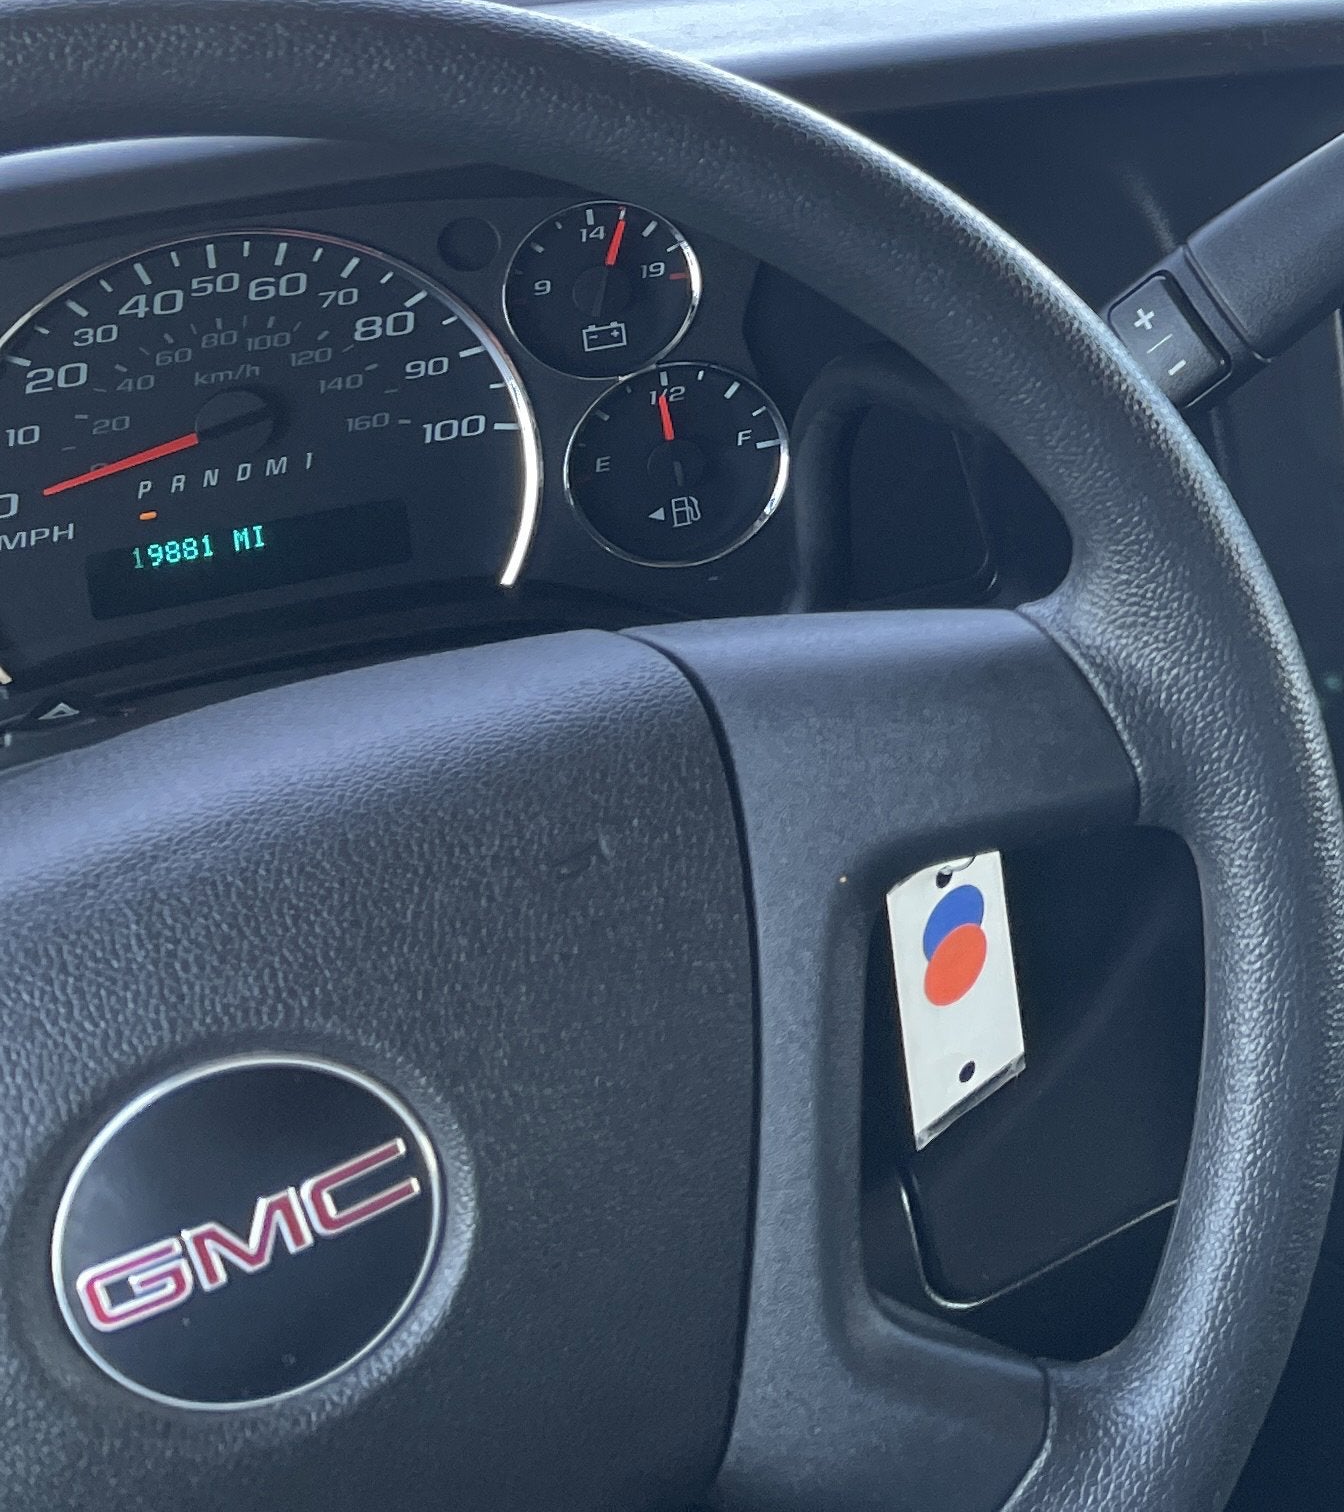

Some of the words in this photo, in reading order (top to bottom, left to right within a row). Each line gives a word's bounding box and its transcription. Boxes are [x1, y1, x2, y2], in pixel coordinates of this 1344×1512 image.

[579, 225, 606, 243] 14
[640, 261, 666, 280] 19
[190, 271, 240, 297] 50
[247, 272, 308, 301] 60
[533, 279, 552, 296] 9
[117, 289, 184, 318] 40
[318, 286, 360, 308] 70
[72, 324, 118, 347] 30
[353, 309, 418, 343] 80
[201, 329, 238, 349] 80
[246, 331, 292, 351] 100
[154, 347, 193, 366] 60
[290, 347, 333, 367] 120
[25, 362, 88, 395] 20
[194, 364, 261, 386] km/h
[404, 356, 450, 380] 90
[116, 374, 155, 393] 40
[318, 371, 364, 393] 140
[92, 415, 131, 435] 20
[345, 411, 391, 433] 160
[422, 414, 487, 444] 100
[5, 425, 41, 448] 10
[736, 429, 753, 447] F
[595, 455, 612, 473] E
[0, 522, 74, 551] MPH
[132, 534, 214, 570] 19881
[232, 524, 266, 553] MI
[76, 1136, 422, 1334] GMC
